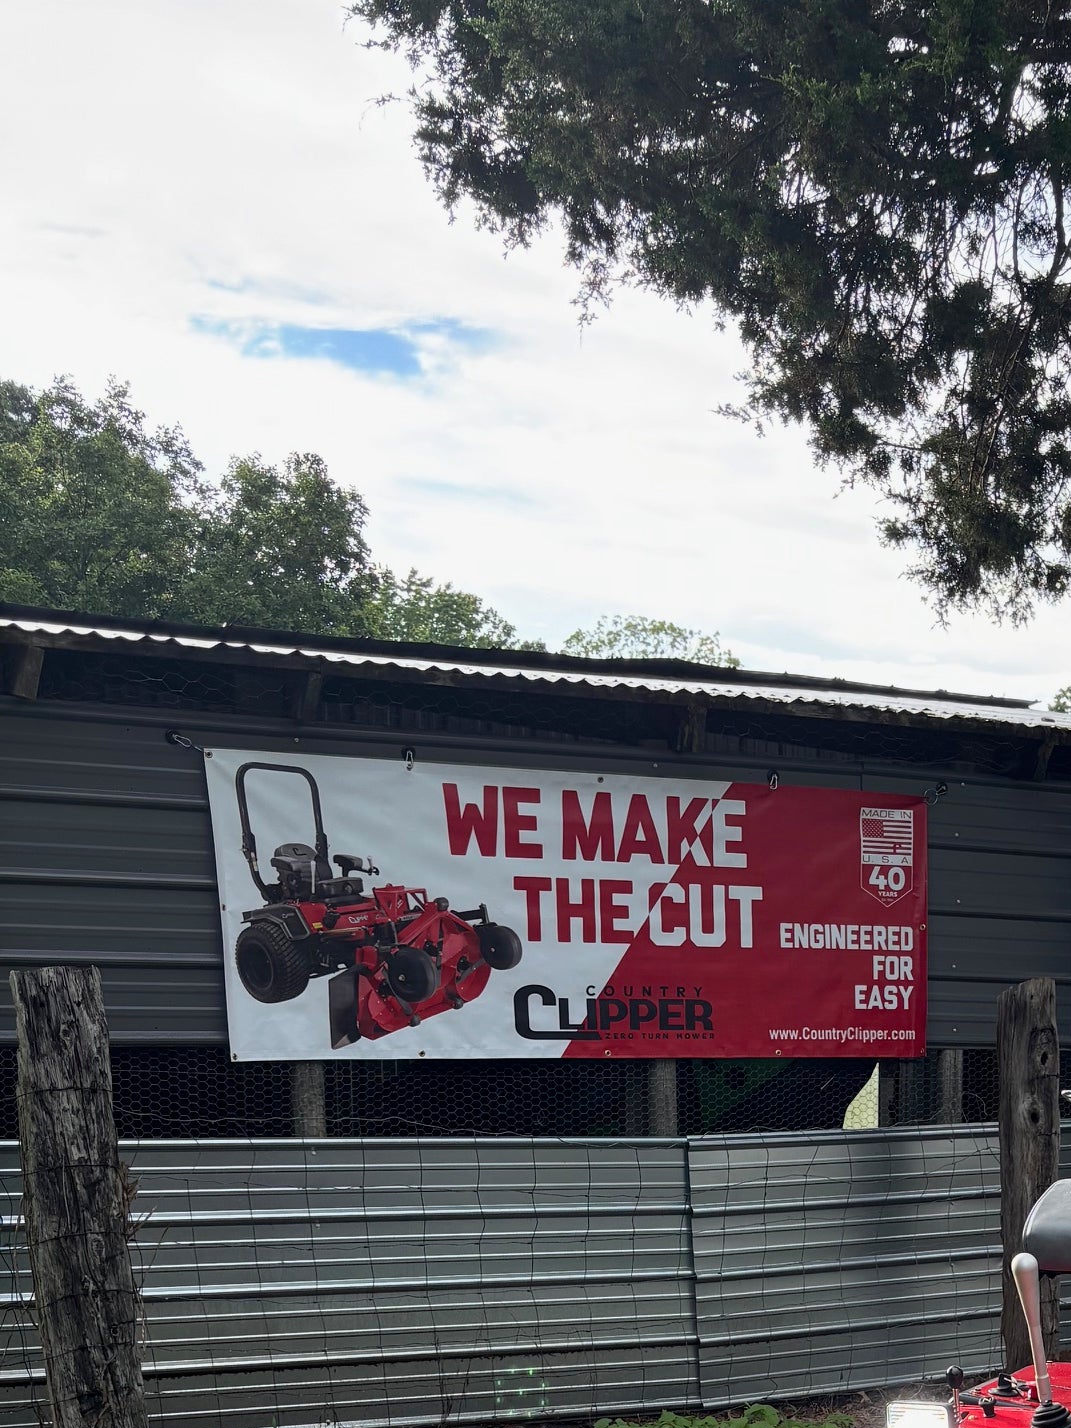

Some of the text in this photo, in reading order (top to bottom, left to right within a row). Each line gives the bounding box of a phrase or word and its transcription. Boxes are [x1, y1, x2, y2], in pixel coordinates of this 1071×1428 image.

[442, 783, 747, 868] WE MAKE
[861, 808, 912, 819] MADE IN
[868, 866, 905, 891] 40
[513, 876, 763, 948] THE CUT
[779, 922, 914, 951] ENGINEERED
[872, 955, 914, 981] FOR
[585, 985, 703, 997] COUNTRY
[854, 985, 914, 1010] EASY
[513, 984, 714, 1041] CLIPPER
[604, 1032, 715, 1040] ZERO TURN MOWER
[769, 1026, 916, 1043] www.CountryClipper.com
